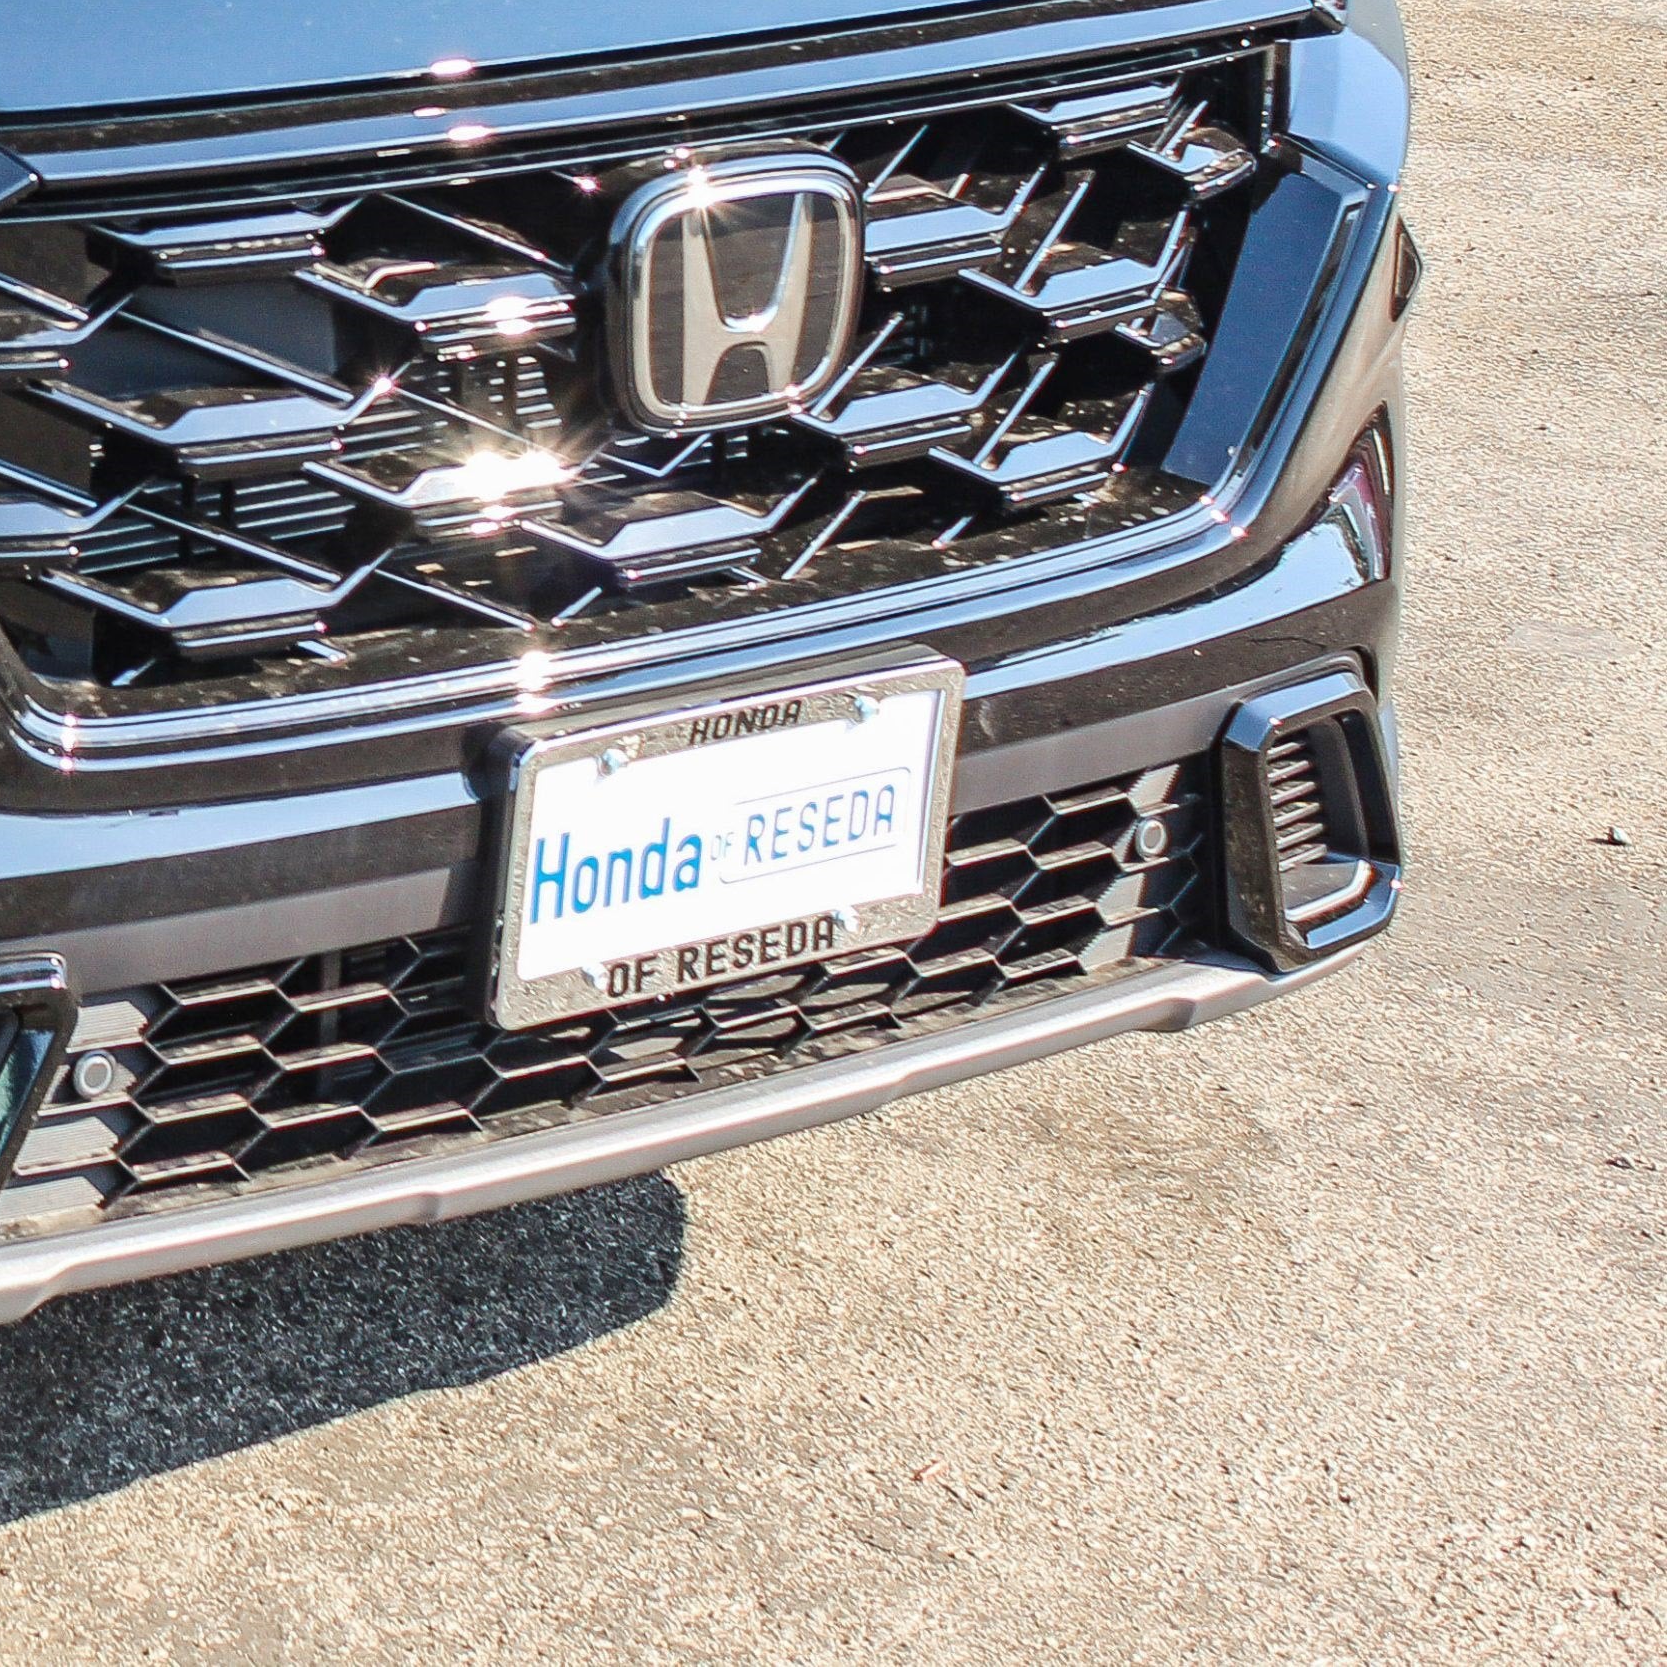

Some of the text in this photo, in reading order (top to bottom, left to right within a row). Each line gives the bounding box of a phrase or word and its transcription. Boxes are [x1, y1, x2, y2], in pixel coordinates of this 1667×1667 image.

[688, 698, 803, 745] HONDA
[528, 817, 702, 924] Honda
[743, 782, 897, 866] RESEDA
[607, 914, 836, 999] OF RESEDA
